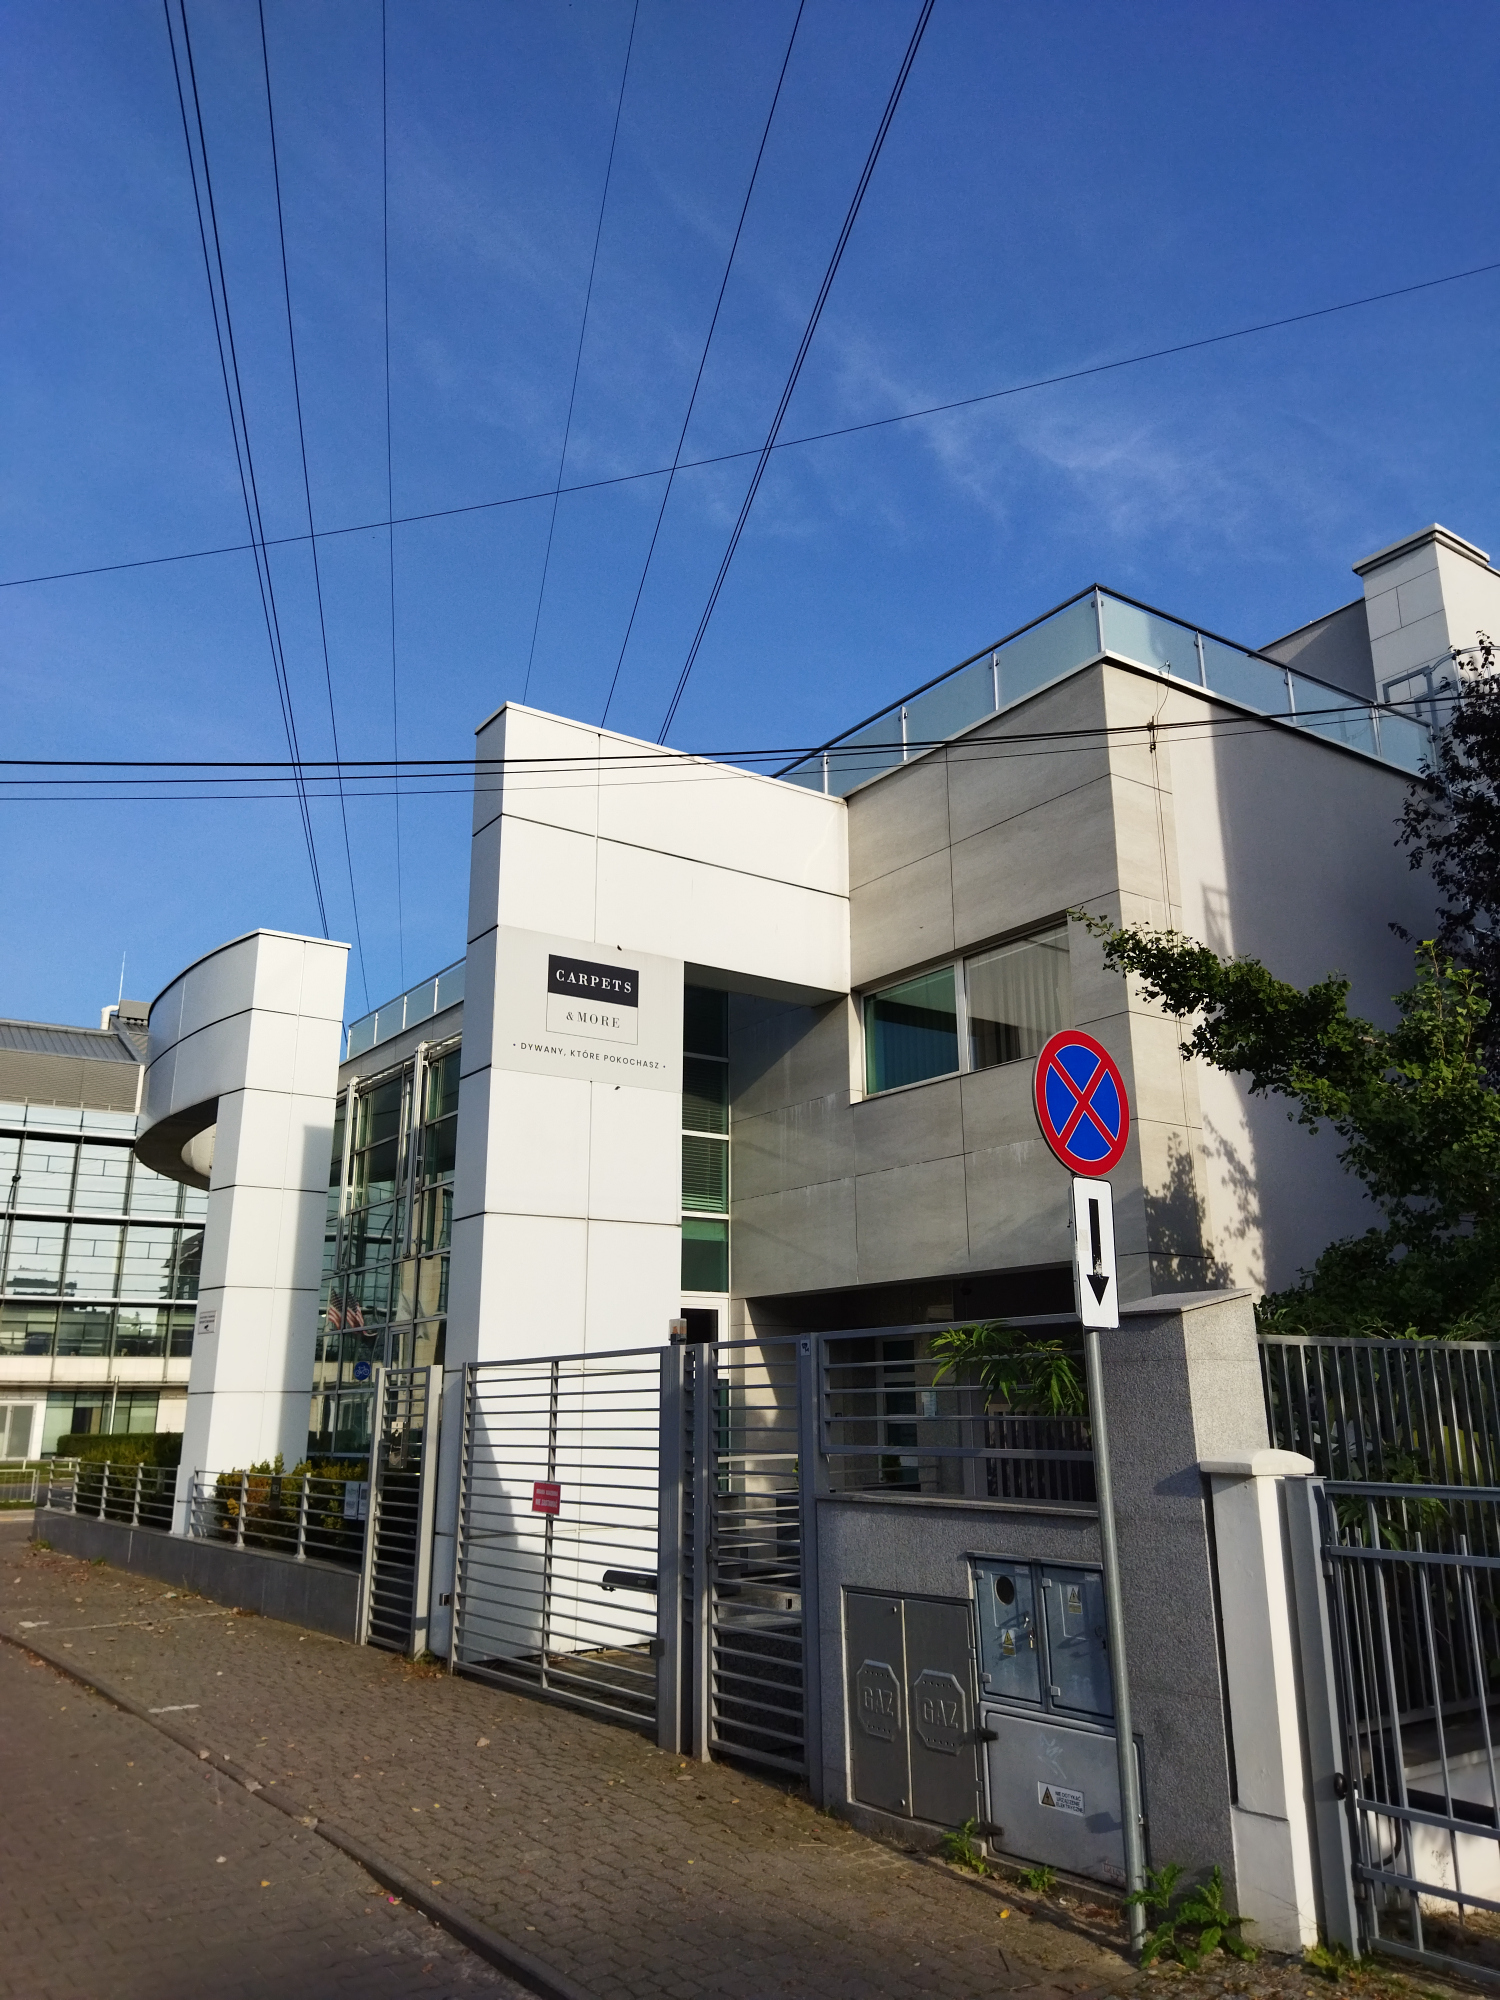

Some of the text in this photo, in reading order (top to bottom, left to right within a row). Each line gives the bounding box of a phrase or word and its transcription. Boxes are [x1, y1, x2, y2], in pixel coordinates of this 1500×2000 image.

[556, 969, 632, 994] CARPETS
[521, 1043, 659, 1069] DYWANY, KTÓRE POKOCHASZ
[864, 1687, 894, 1717] GAZ
[924, 1697, 959, 1728] GAZ
